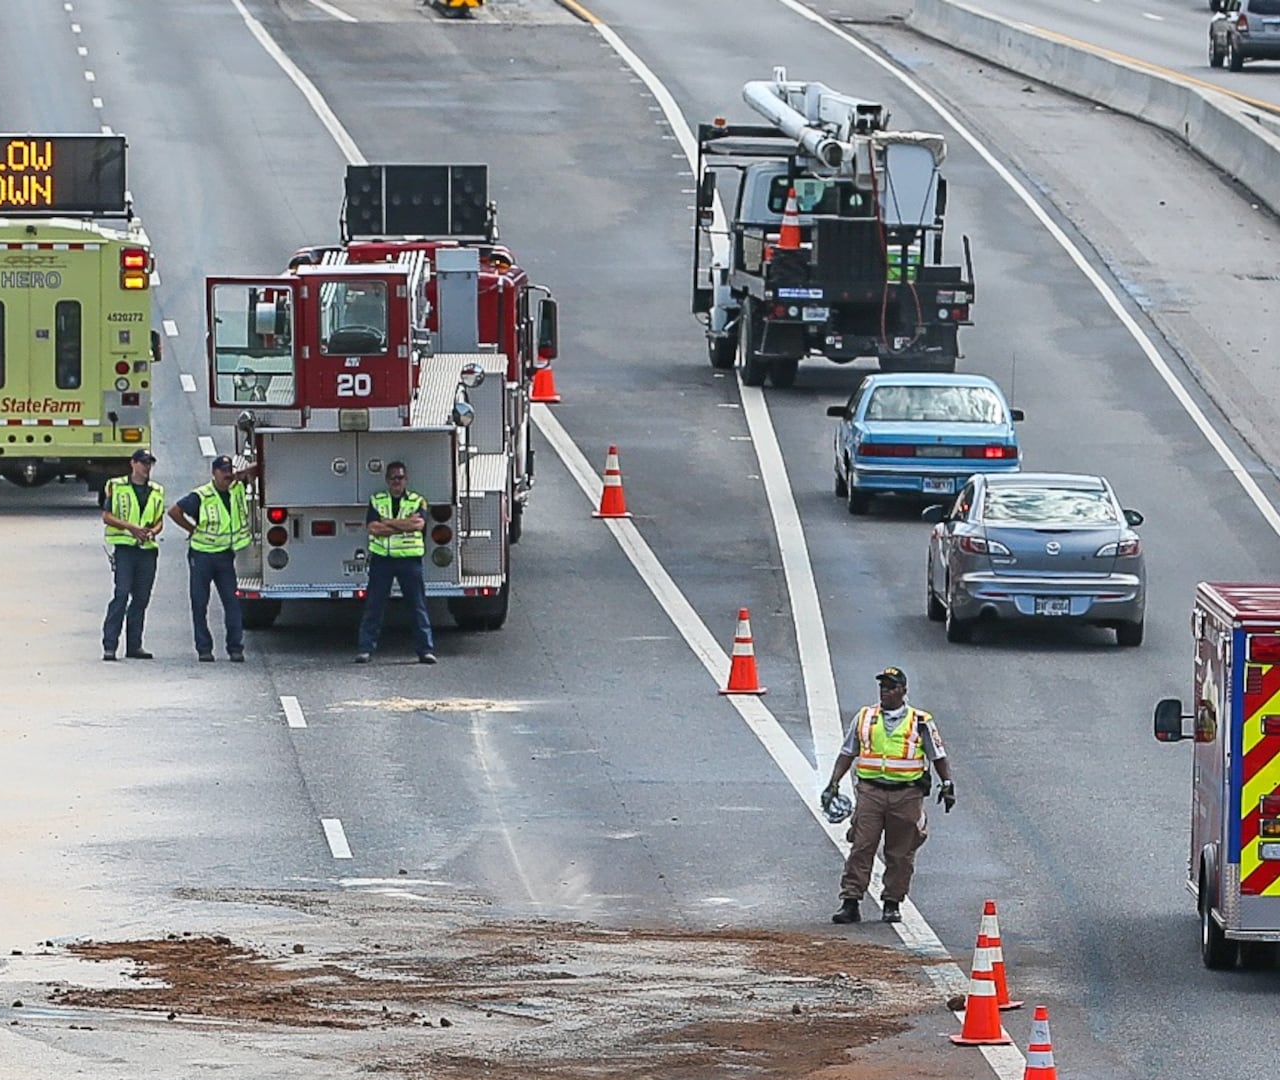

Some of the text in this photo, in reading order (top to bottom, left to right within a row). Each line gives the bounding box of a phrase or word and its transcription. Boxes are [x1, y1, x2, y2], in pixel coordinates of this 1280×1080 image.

[1, 271, 62, 288] HERO
[107, 312, 144, 322] 4520272
[336, 373, 372, 397] 20
